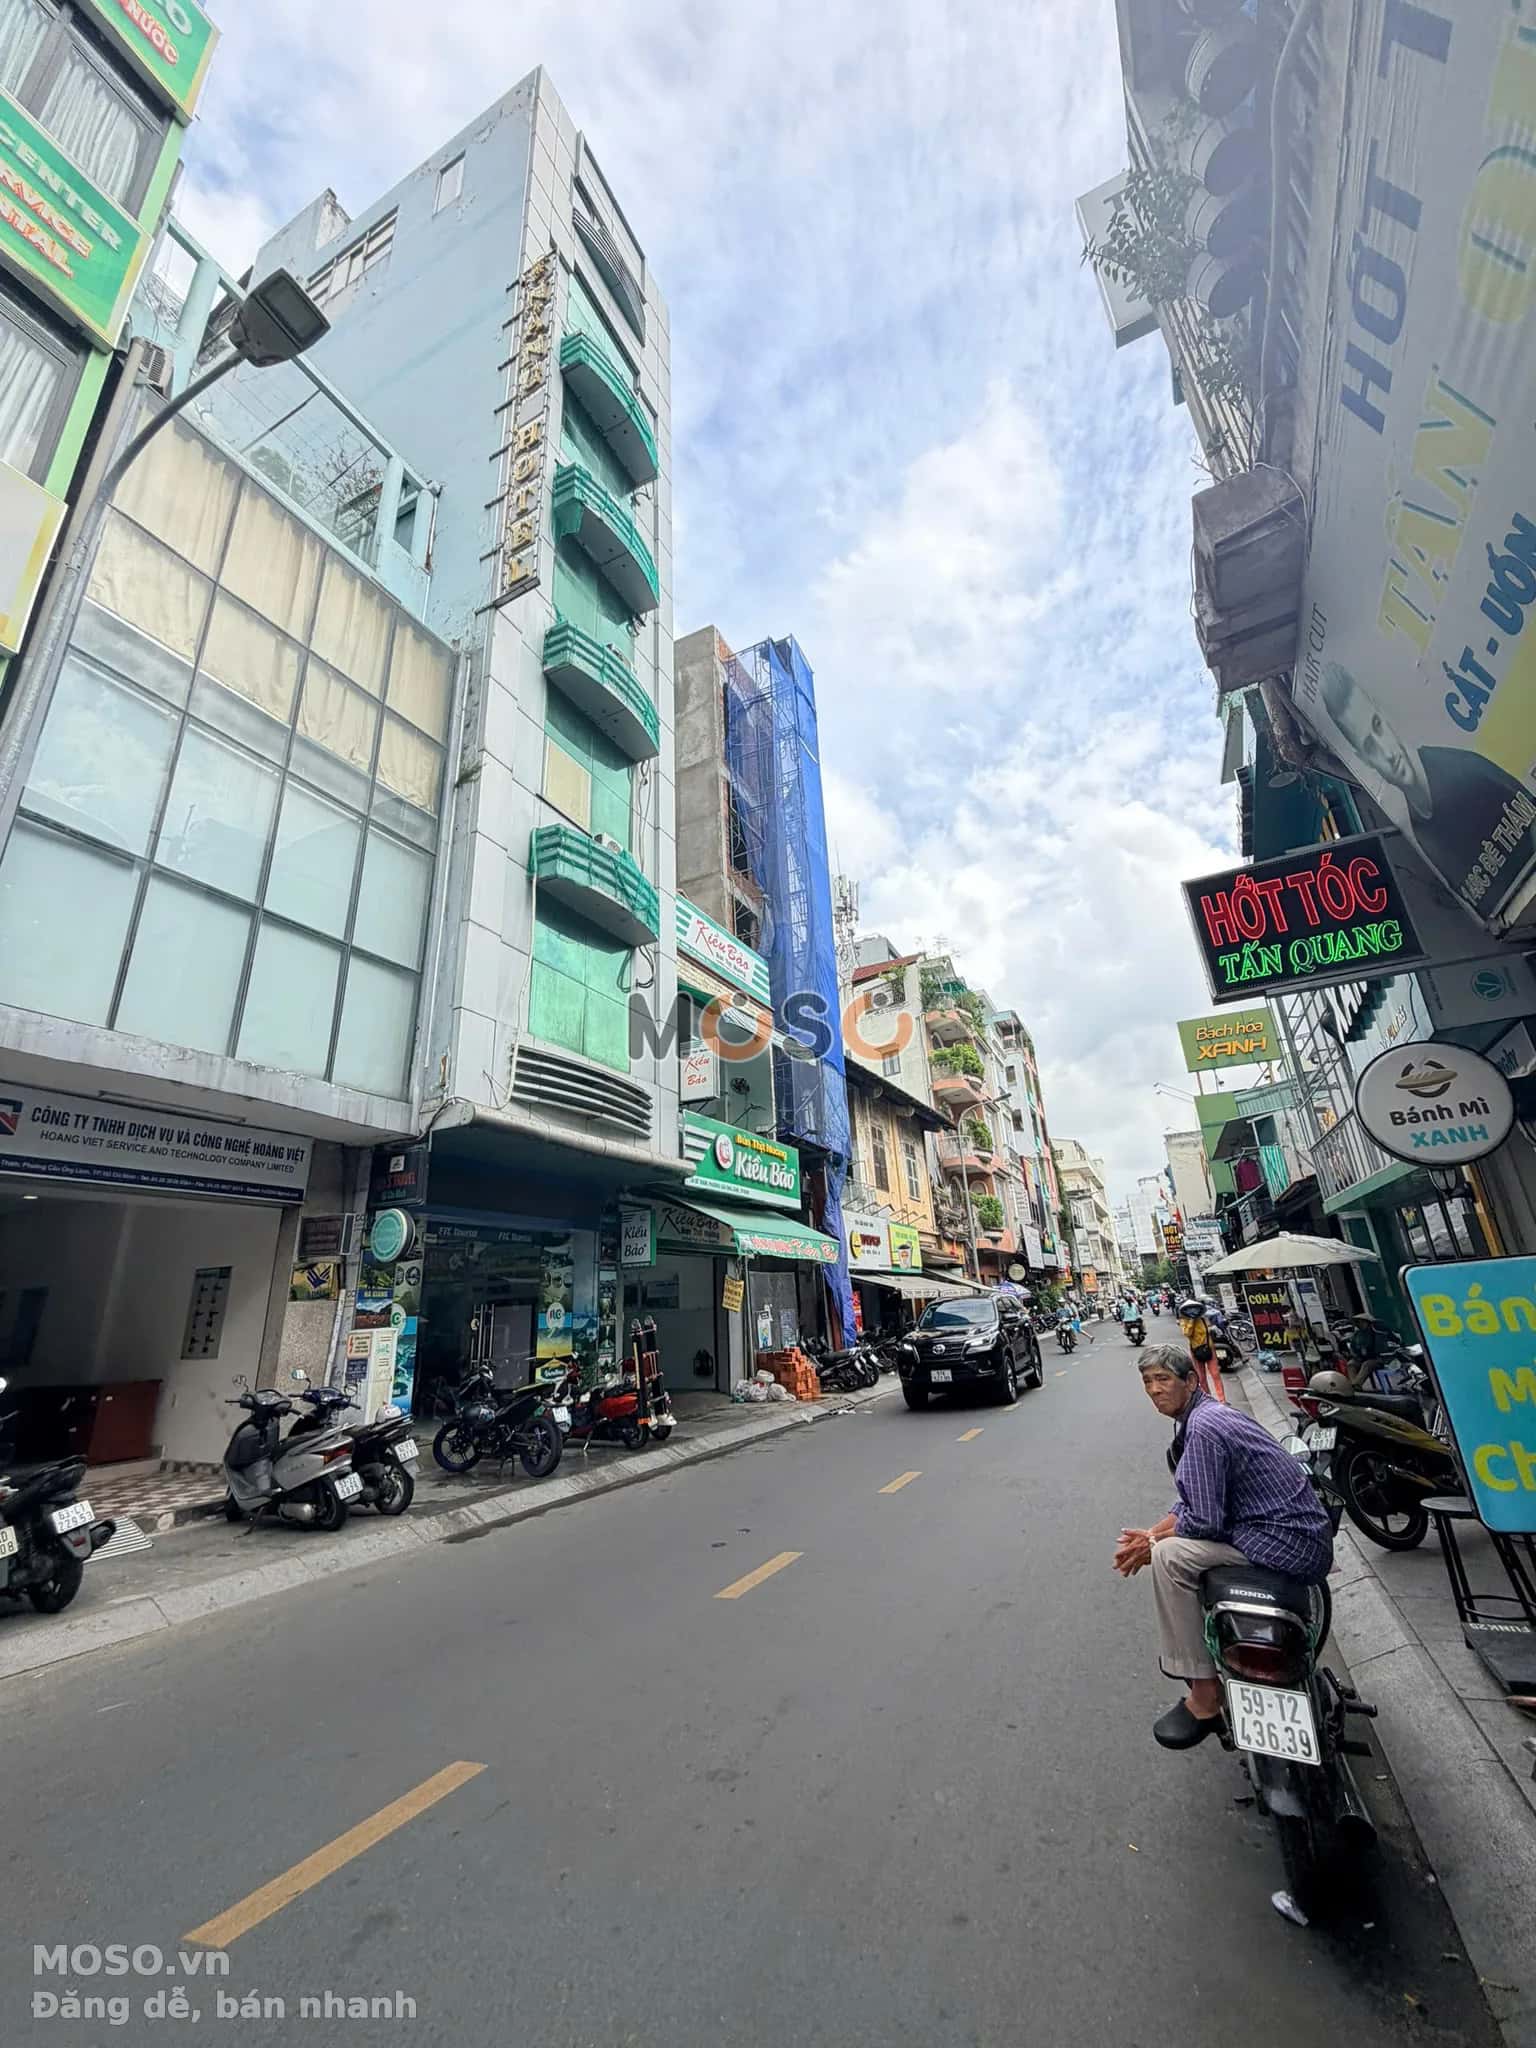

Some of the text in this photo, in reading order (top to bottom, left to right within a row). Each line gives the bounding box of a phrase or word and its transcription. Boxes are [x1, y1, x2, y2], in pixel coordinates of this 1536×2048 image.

[505, 421, 541, 588] HOTEL
[1302, 603, 1329, 704] HAIR CUT
[1200, 853, 1388, 947] HỚT TÓC
[1219, 920, 1404, 983] TẤN QUANG
[1196, 1017, 1264, 1041] Bách hóa
[1197, 1036, 1268, 1061] XANH
[1389, 1096, 1491, 1126] Bánh Mì
[31, 1106, 306, 1165] CÔNG TY TNHH DỊCH VỤ VÀ CÔNG NGHỆ HOÀNG VIỆT
[40, 1130, 295, 1174] HOANG VIET SERVICE AND TECHNOLOGY COMPANY LIMITED
[1411, 1125, 1489, 1149] XANH
[734, 1151, 768, 1184] Kiều
[769, 1162, 795, 1190] Bảo
[625, 1224, 647, 1240] Kiều
[625, 1241, 644, 1258] Bảo
[1419, 1282, 1536, 1337] Bán
[1488, 1358, 1536, 1413] M
[1229, 1588, 1276, 1601] HONDA
[1240, 1686, 1302, 1724] 59-T2
